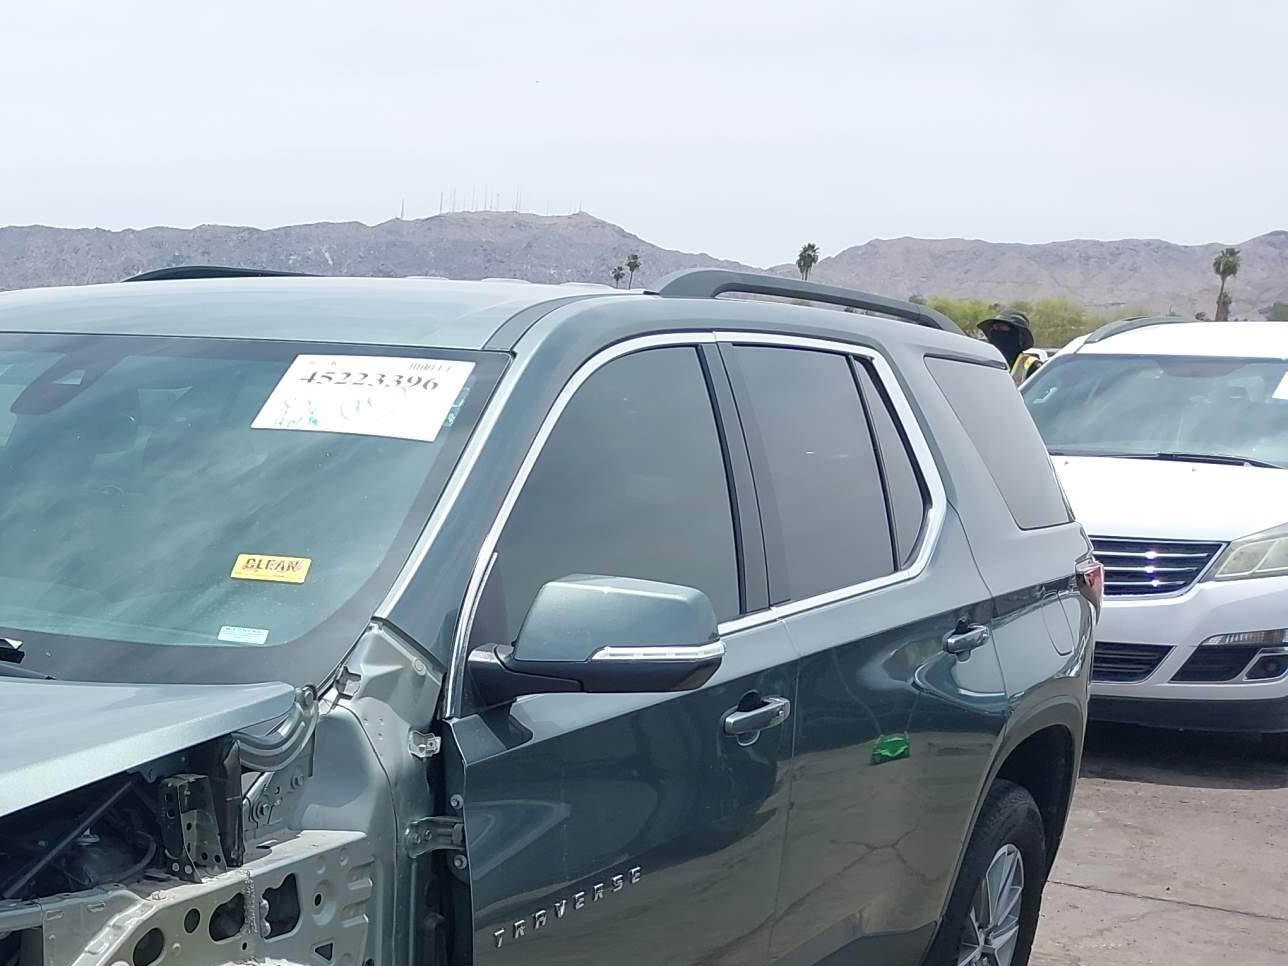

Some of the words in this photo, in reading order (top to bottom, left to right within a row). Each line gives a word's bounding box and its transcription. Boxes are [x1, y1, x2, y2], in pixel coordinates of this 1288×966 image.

[299, 370, 440, 391] 45223396
[244, 558, 300, 572] CLEAN
[493, 866, 641, 948] TRAVERSE
